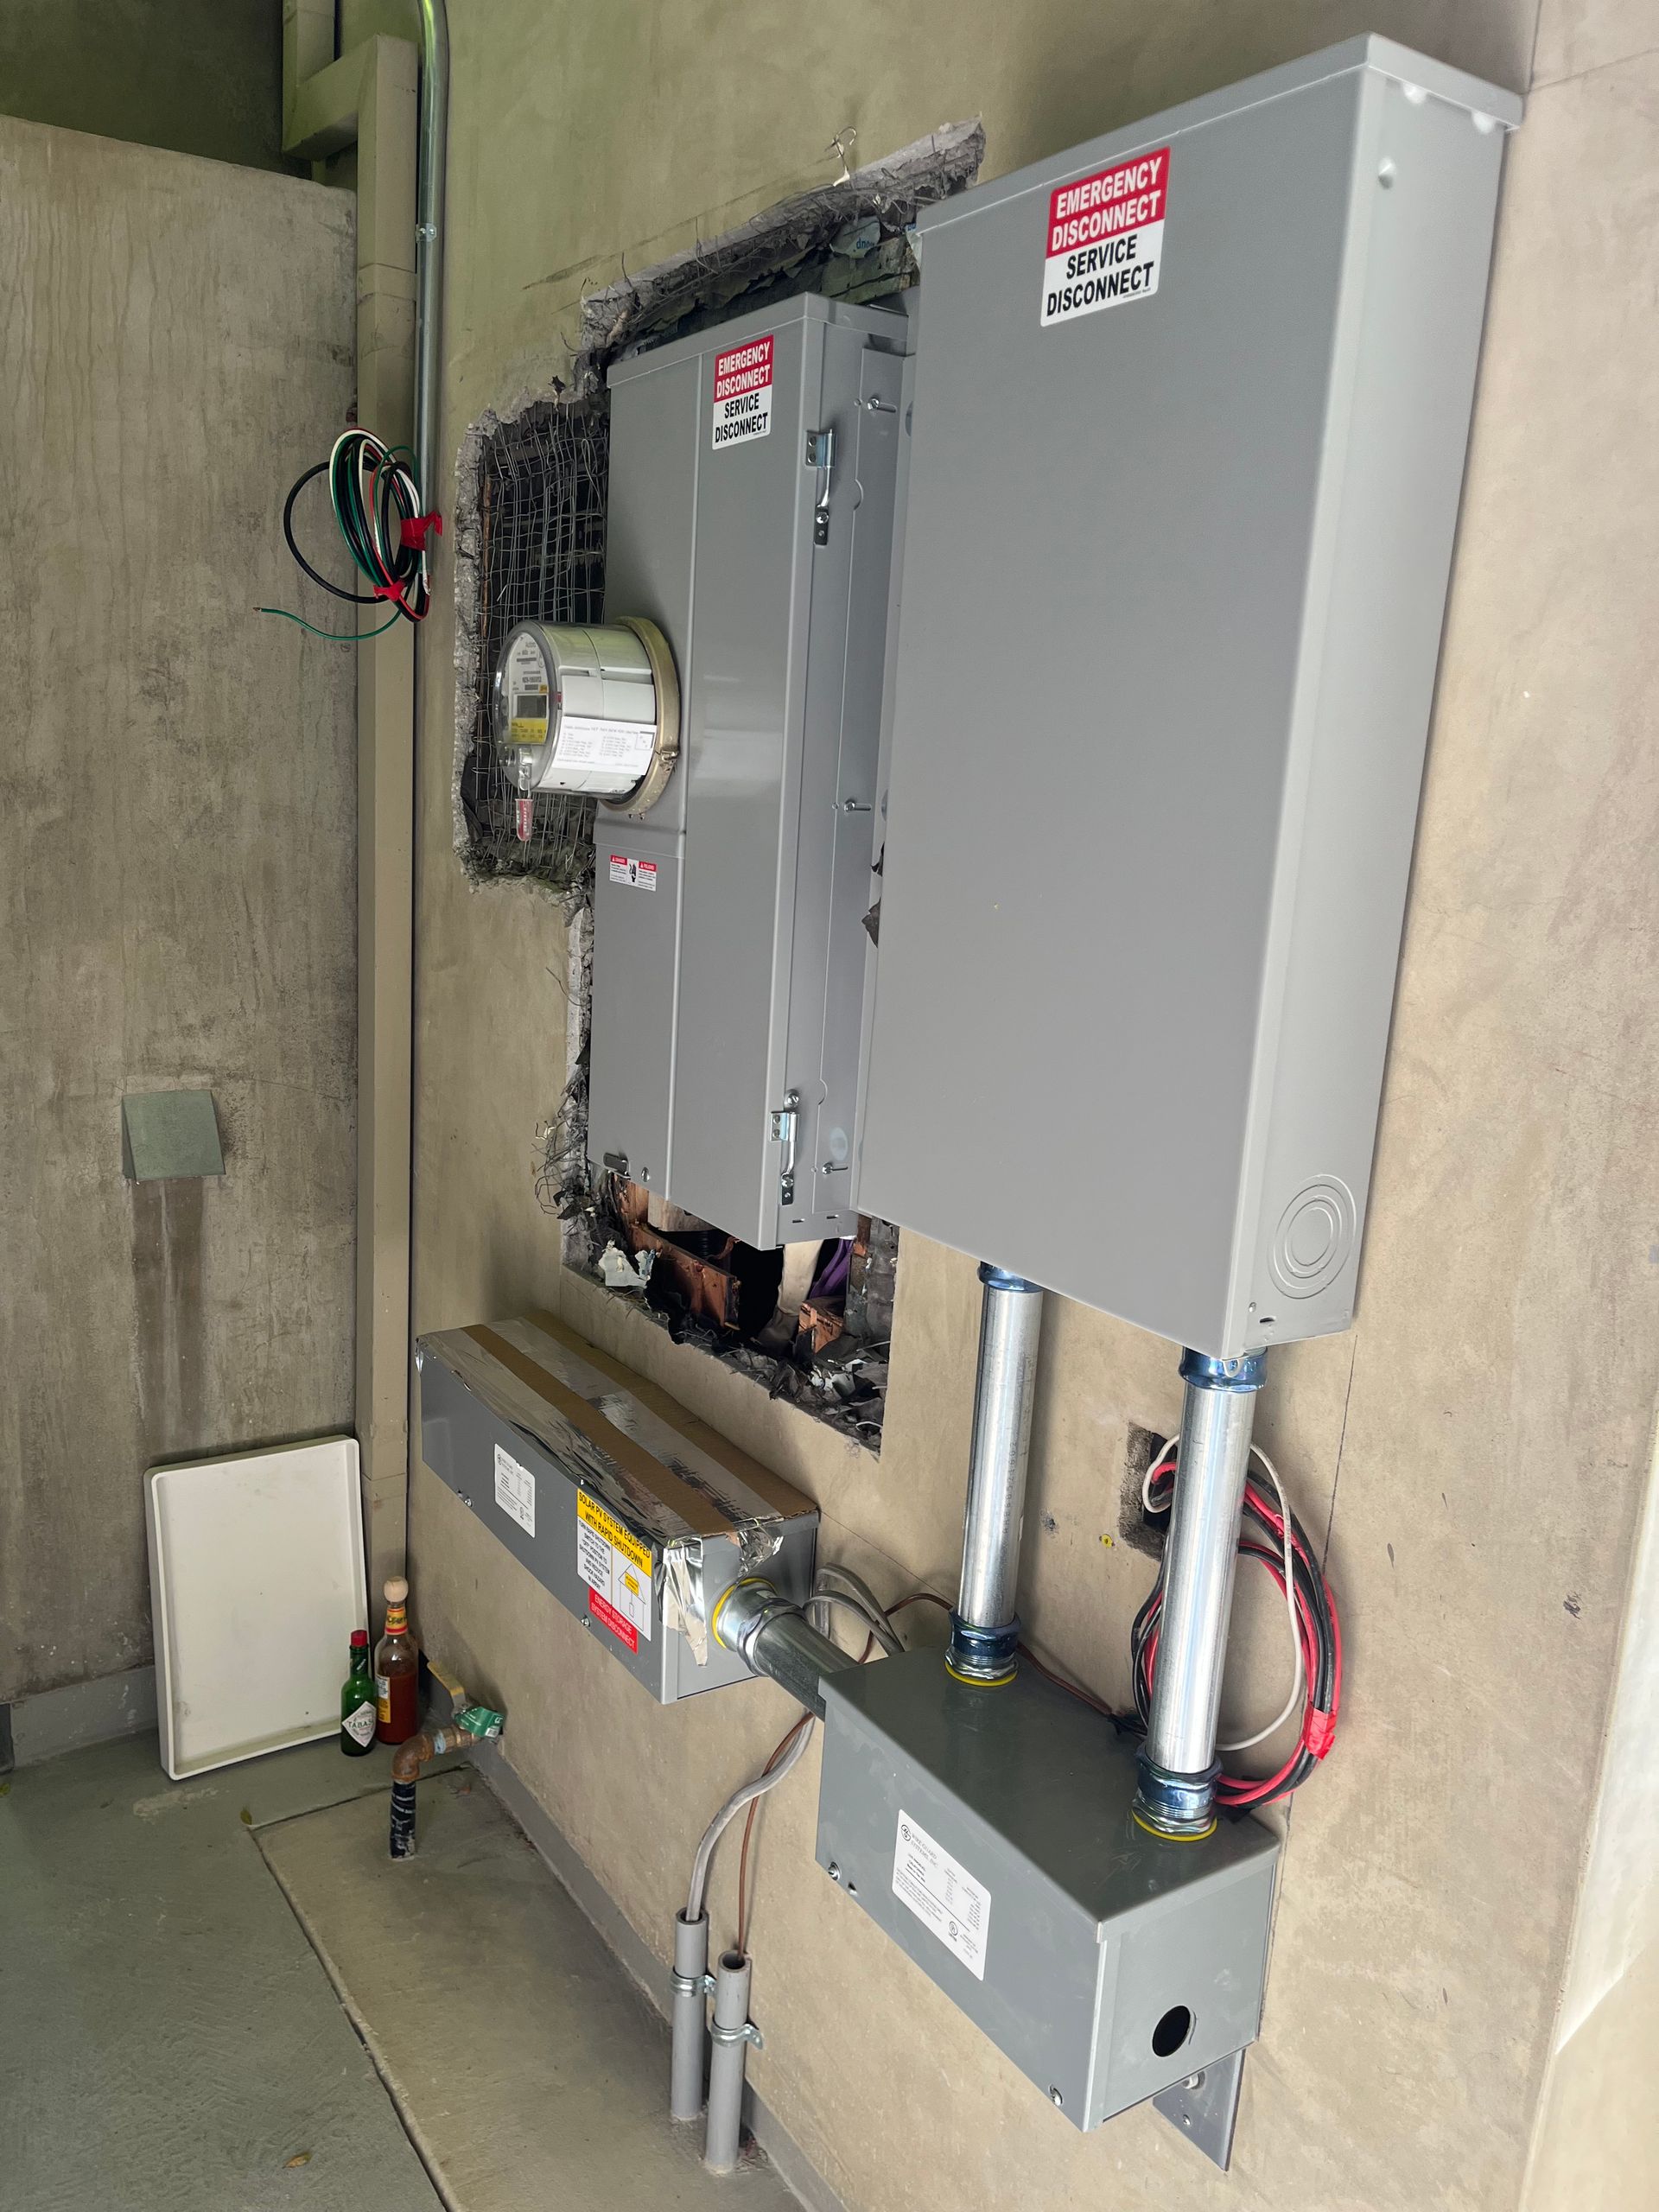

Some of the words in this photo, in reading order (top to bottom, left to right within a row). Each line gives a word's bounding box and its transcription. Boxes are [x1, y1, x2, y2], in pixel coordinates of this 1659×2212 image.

[1057, 156, 1162, 219] EMERGENCY
[1052, 189, 1161, 251] DISCONNECT
[1066, 234, 1137, 279] SERVICE
[1047, 261, 1154, 316] DISCONNECT
[716, 364, 770, 398] DISCONNECT
[718, 341, 770, 376] EMERGENCY
[715, 412, 767, 442] DISCONNECT
[725, 392, 759, 418] SERVICE
[579, 1492, 594, 1512] SOLAR
[596, 1506, 602, 1517] PV
[604, 1512, 623, 1535] SYSTEM
[624, 1529, 650, 1558] EQUIPPED
[585, 1511, 597, 1527] WITH
[598, 1522, 613, 1541] RAPID
[613, 1535, 642, 1567] SHUTDOWN
[591, 1603, 607, 1624] SYSTEM
[607, 1618, 634, 1648] DISCONNECT
[594, 1594, 611, 1614] ENERGY
[612, 1609, 632, 1634] STORAGE
